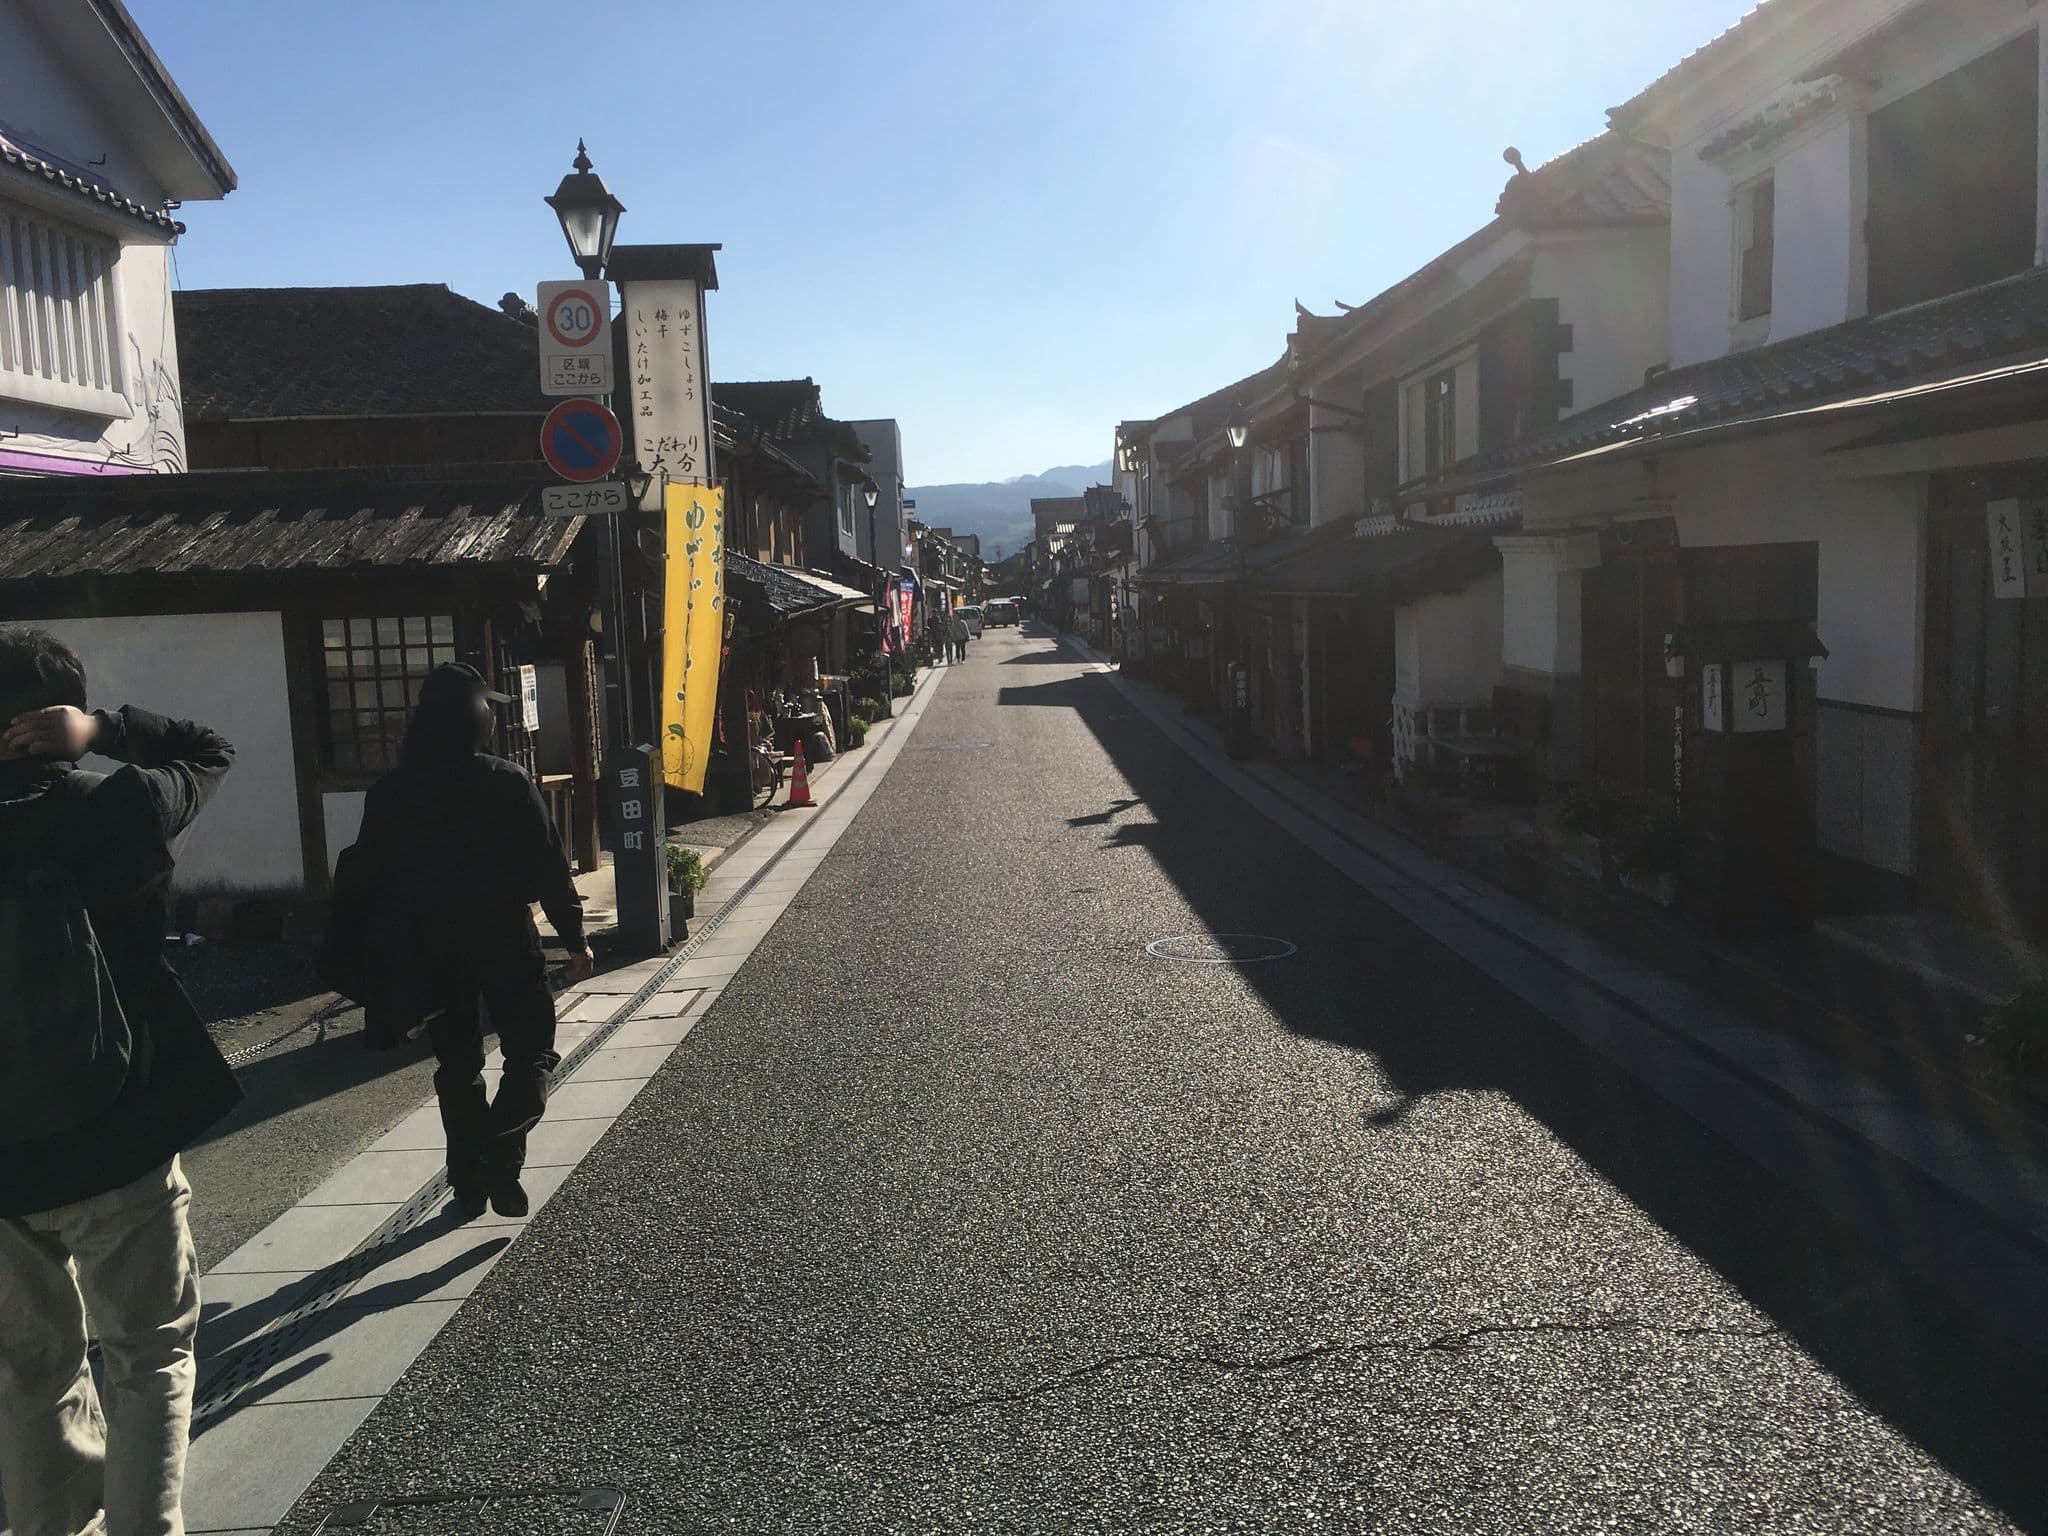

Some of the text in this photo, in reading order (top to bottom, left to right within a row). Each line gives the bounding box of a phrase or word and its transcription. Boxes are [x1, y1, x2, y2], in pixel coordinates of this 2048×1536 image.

[560, 305, 590, 331] 30
[654, 308, 671, 339] 梅干
[634, 309, 653, 417] しいたけ加工品
[679, 308, 695, 401] ゆずこしょう
[554, 372, 602, 386] ここから
[643, 434, 698, 453] こだわり
[649, 453, 697, 473] 大分
[548, 489, 621, 510] ここから
[619, 767, 645, 851] 豆田町
